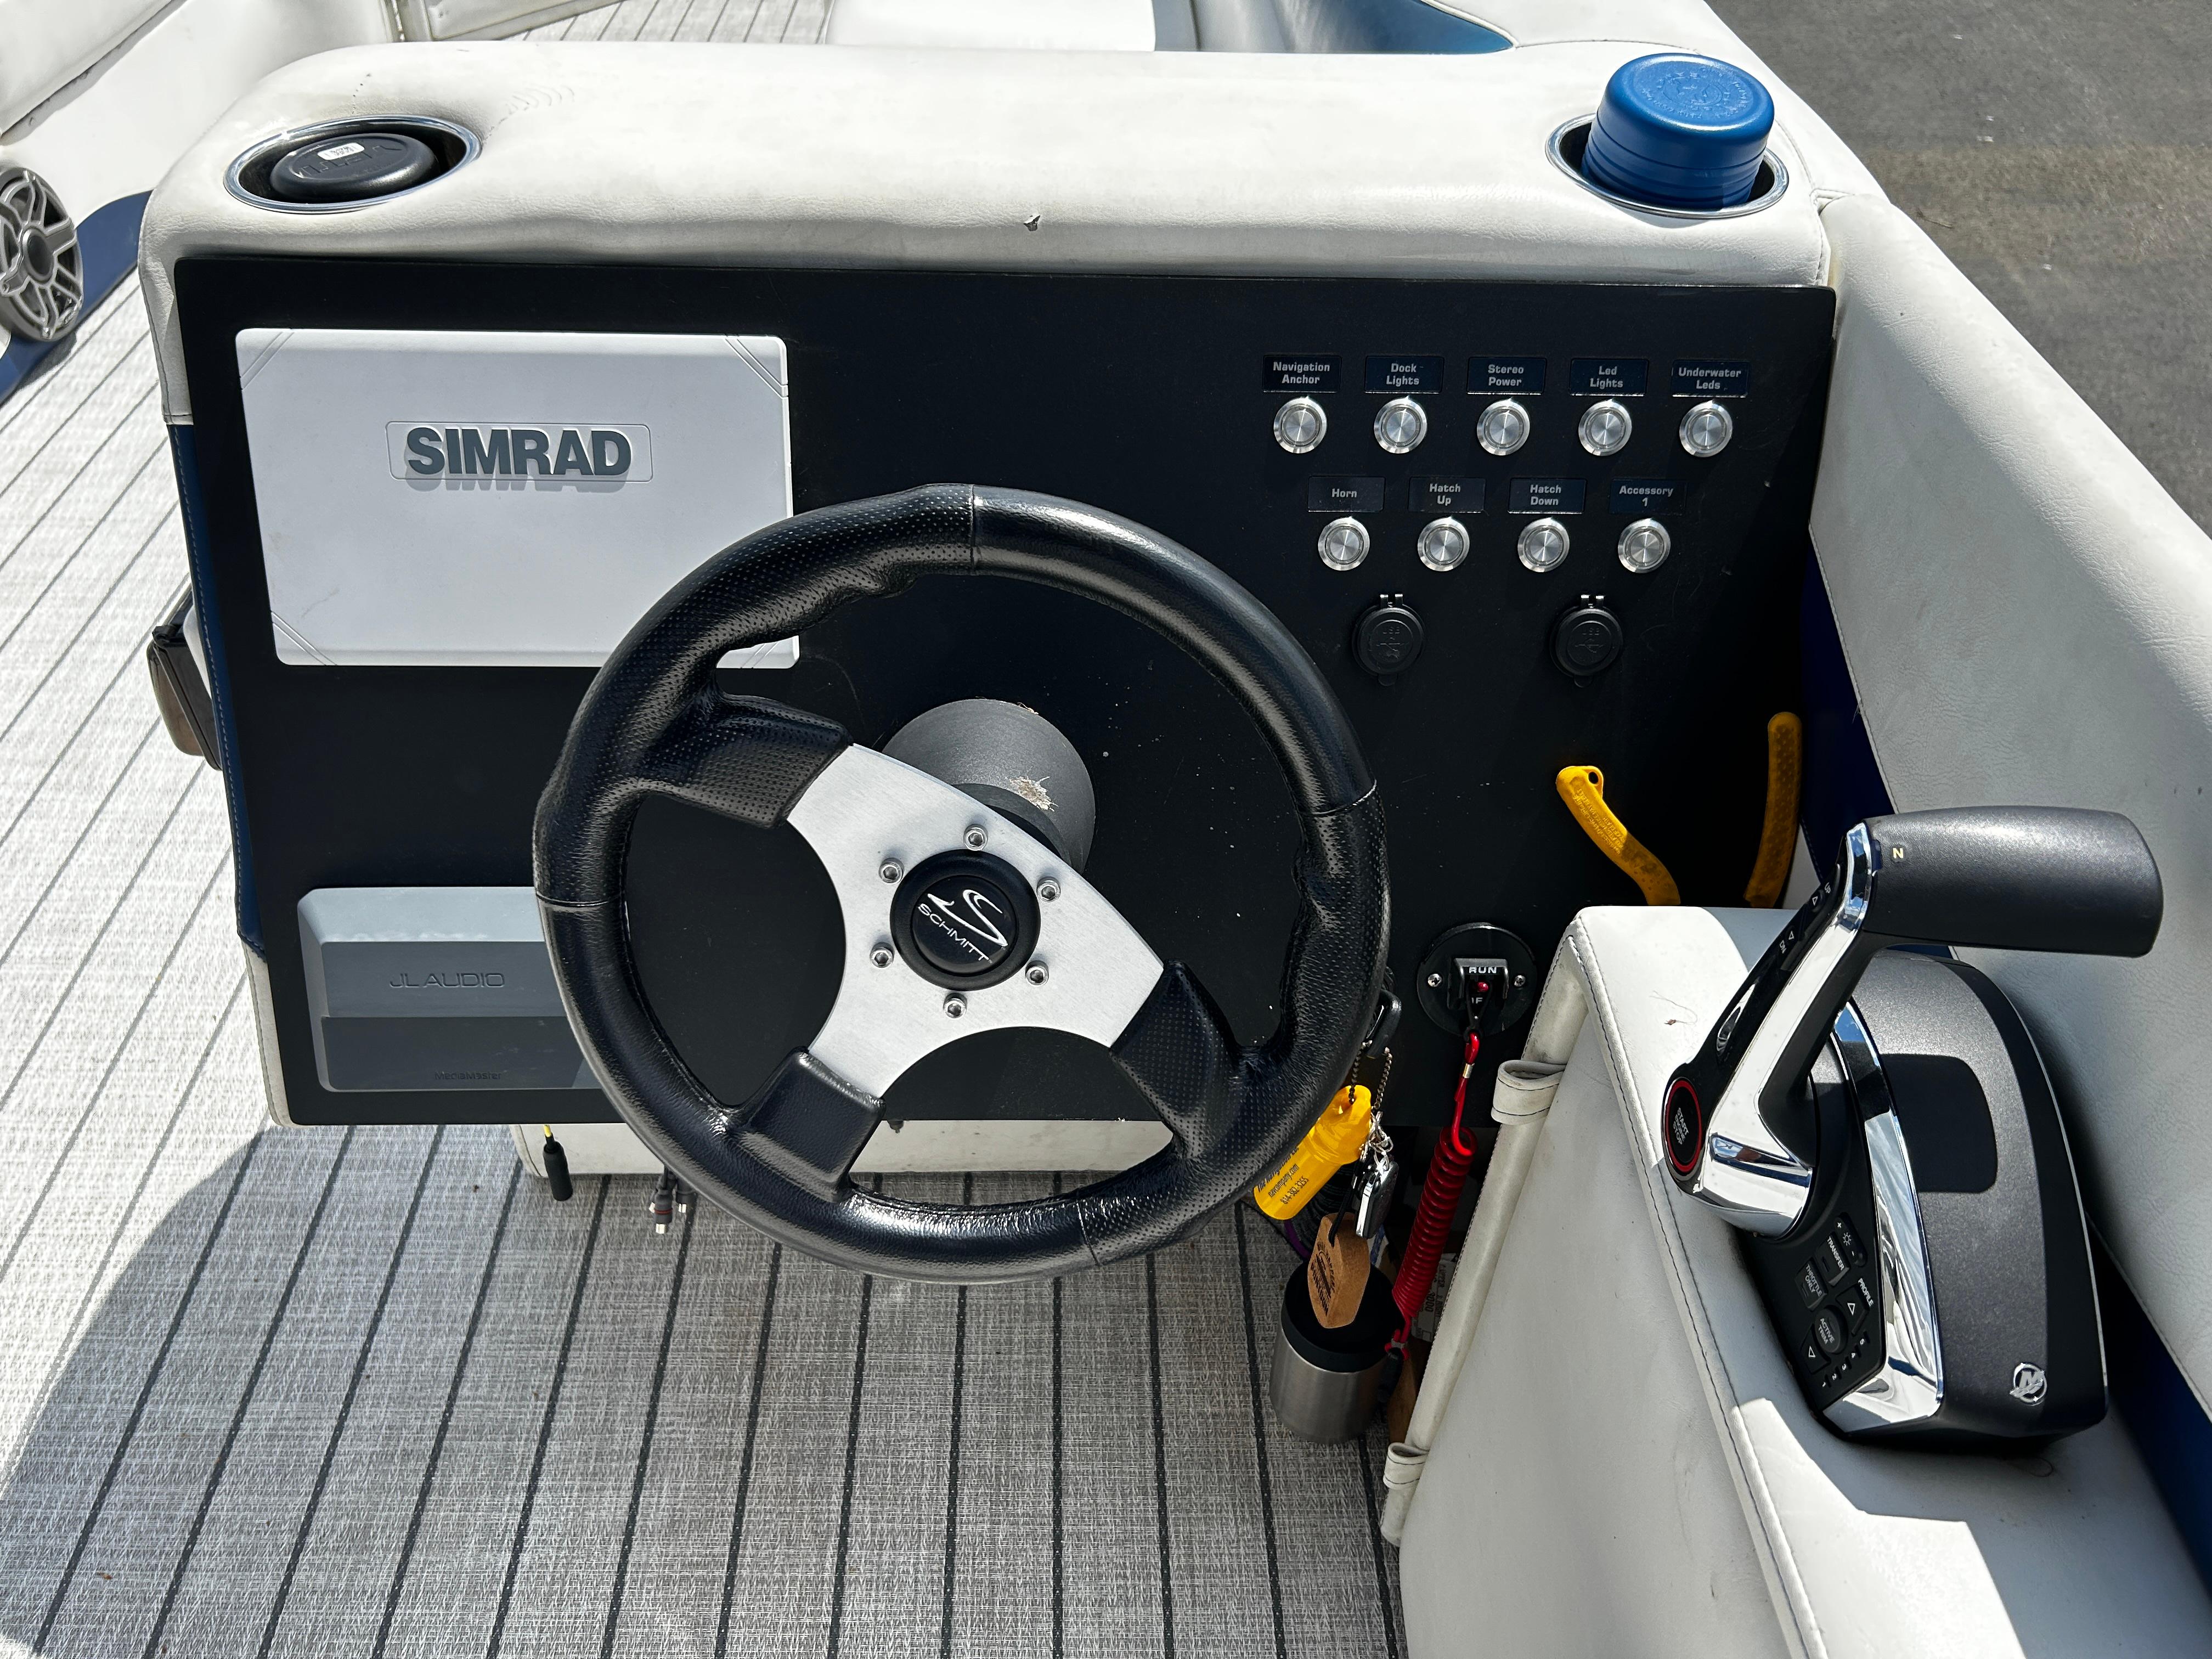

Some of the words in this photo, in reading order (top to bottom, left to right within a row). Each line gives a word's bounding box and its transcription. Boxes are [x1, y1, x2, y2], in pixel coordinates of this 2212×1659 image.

[1273, 362, 1330, 373] Navigation
[1391, 363, 1417, 373] Dock
[1488, 364, 1524, 374] Stereo
[1598, 366, 1617, 375] Led
[1678, 368, 1742, 378] Underwater
[1282, 374, 1320, 384] Anchor
[1386, 375, 1419, 387] Lights
[1488, 376, 1522, 386] Power
[1590, 378, 1623, 390] Lights
[1696, 380, 1720, 390] Leds
[407, 427, 632, 476] SIMRAD
[1331, 488, 1357, 498] Horn
[1429, 483, 1461, 493] Hatch
[1530, 484, 1562, 494] Hatch
[1618, 486, 1674, 497] Accessory
[1437, 495, 1452, 506] Up
[1530, 496, 1559, 506] Down
[1642, 498, 1648, 507] 1
[1893, 848, 1904, 859] N
[1824, 882, 1831, 894] UP
[918, 903, 990, 962] SCHMITT
[1779, 939, 1787, 954] DN
[390, 973, 420, 988] JL
[423, 973, 505, 988] AUDIO
[435, 1070, 501, 1080] MediaMaster
[1677, 1107, 1689, 1136] START
[1673, 1121, 1683, 1145] STOP
[1827, 1235, 1844, 1271] TRANSFER
[1805, 1263, 1822, 1297] THROTTLE
[1805, 1275, 1816, 1293] ONLY
[1858, 1278, 1874, 1307] PROFILE
[1818, 1324, 1828, 1344] TRIM
[1820, 1318, 1835, 1344] ACTIVE
